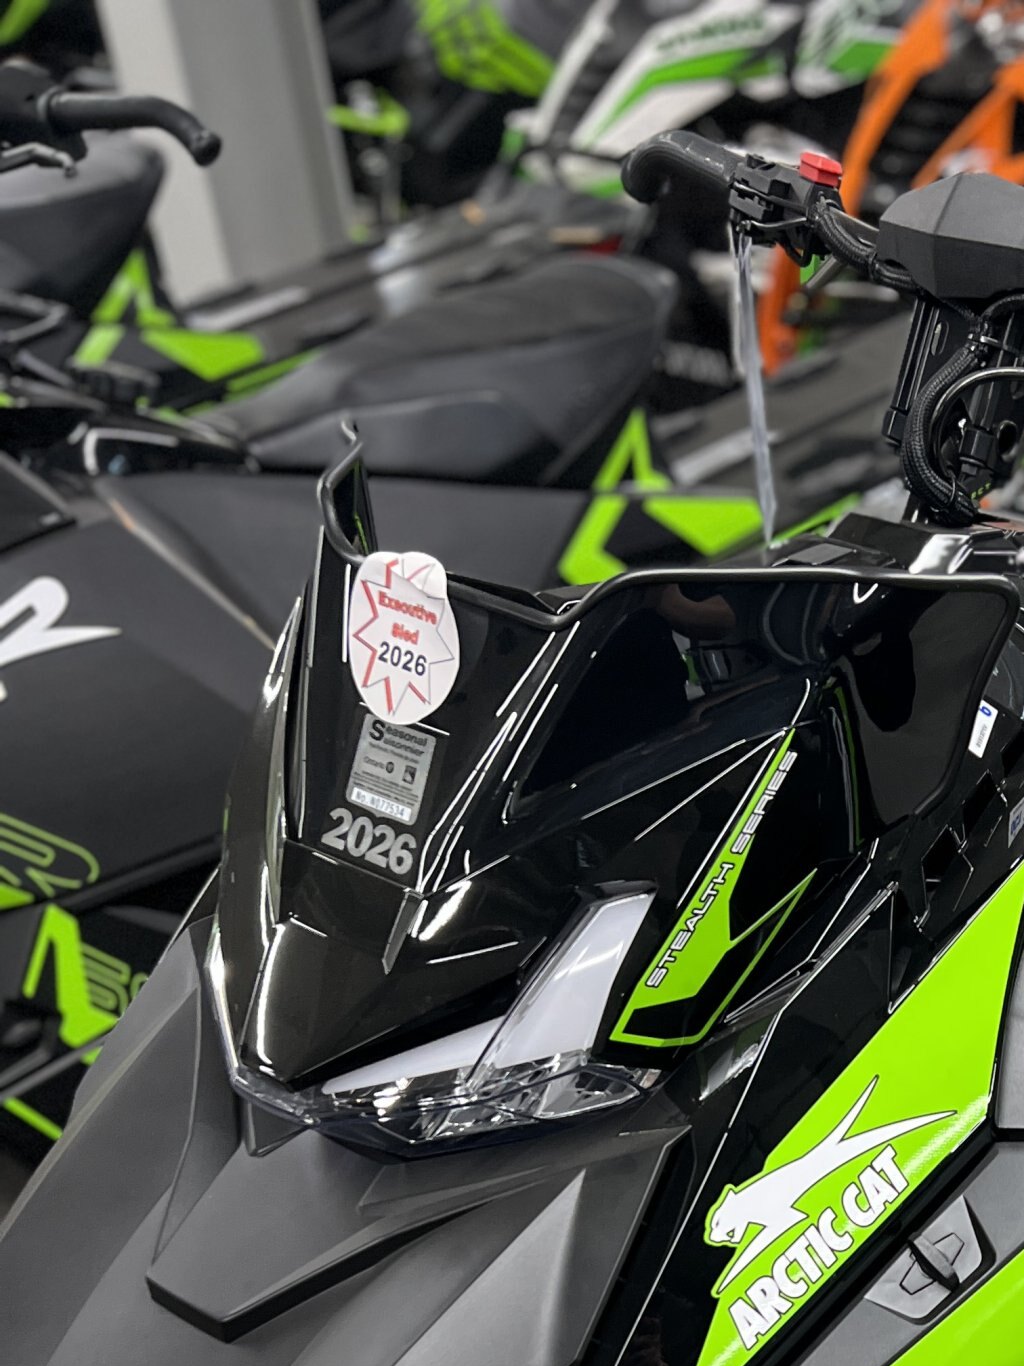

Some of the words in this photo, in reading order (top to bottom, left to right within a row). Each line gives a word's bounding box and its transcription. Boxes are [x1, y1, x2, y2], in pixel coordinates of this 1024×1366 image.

[378, 590, 437, 625] Executive
[391, 622, 420, 646] Sled
[377, 640, 428, 677] 2026
[368, 719, 428, 747] Seasonal
[320, 807, 417, 875] 2026
[646, 862, 733, 987] STEALTH
[731, 750, 798, 854] SERIES
[728, 1204, 854, 1351] ARCTIC
[841, 1144, 910, 1228] CAT
